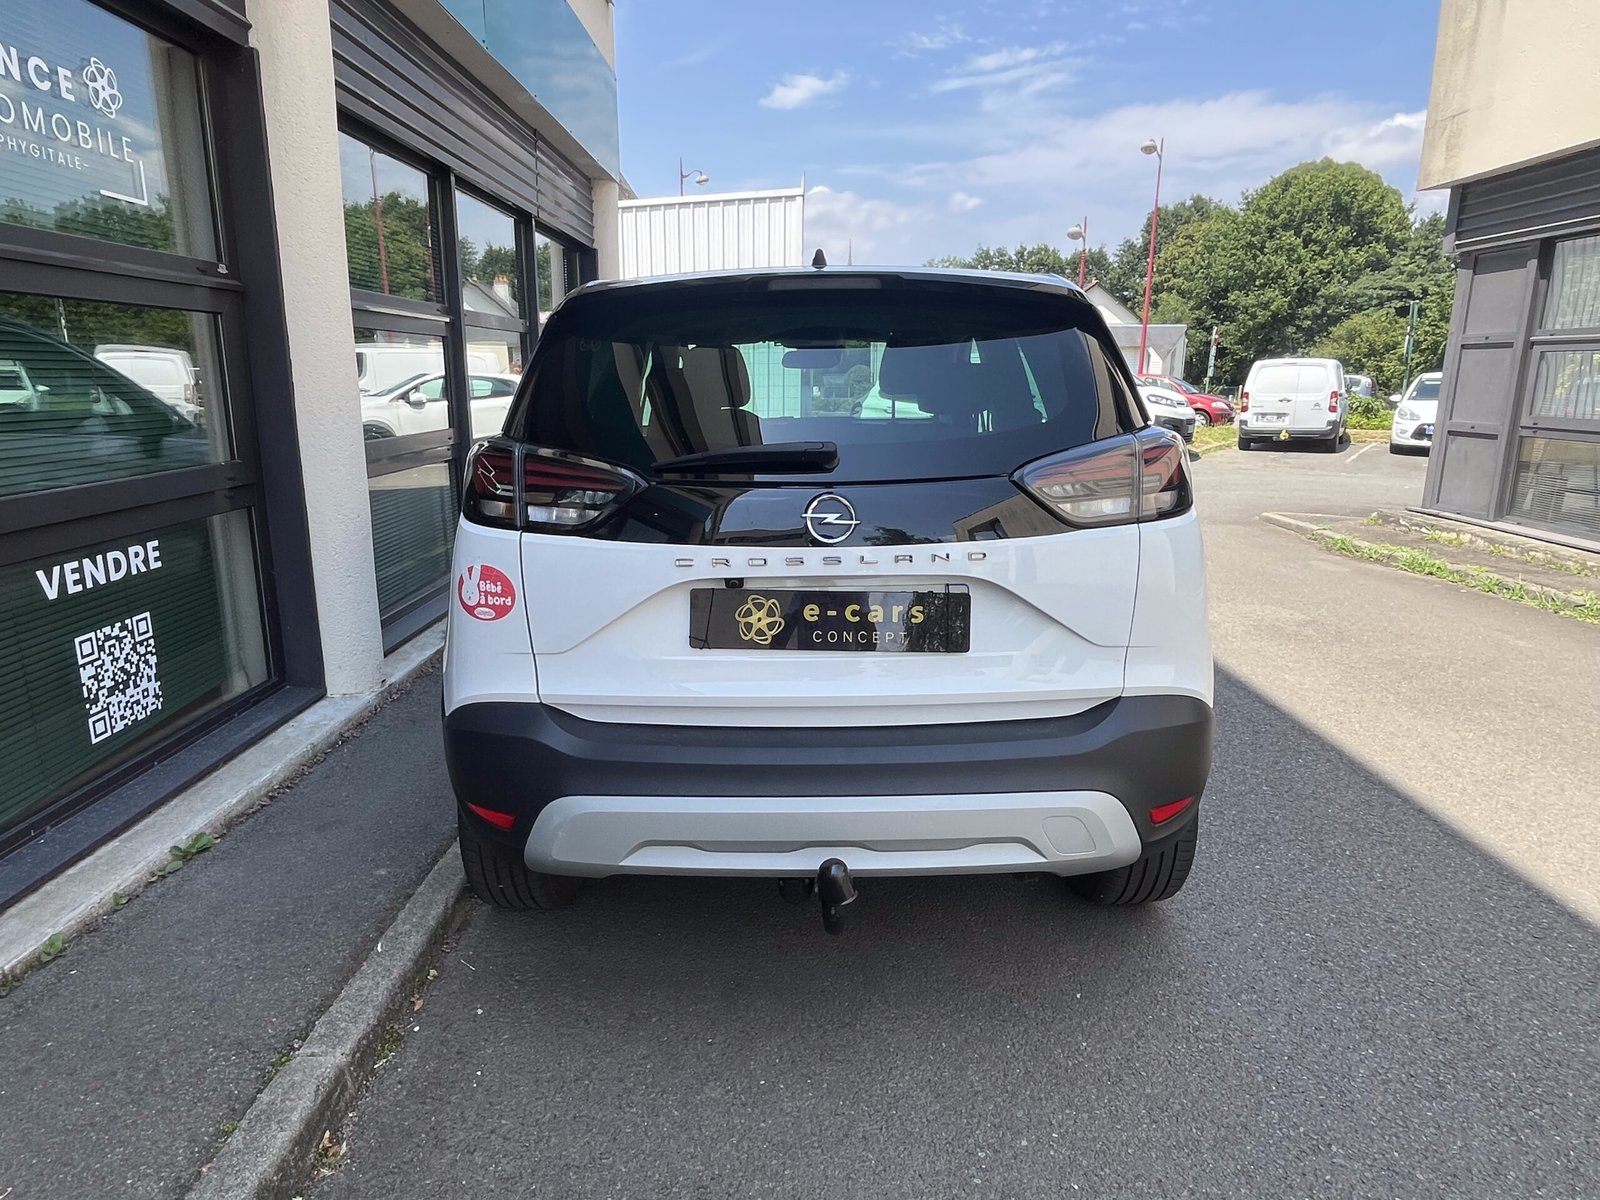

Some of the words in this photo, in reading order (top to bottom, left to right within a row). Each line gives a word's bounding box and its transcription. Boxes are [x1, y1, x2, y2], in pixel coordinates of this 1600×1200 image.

[674, 551, 988, 568] CROSSLAND
[35, 539, 163, 600] VENDRE
[487, 594, 512, 606] bord
[803, 602, 926, 624] e-cars
[812, 630, 909, 646] CONCEPT
